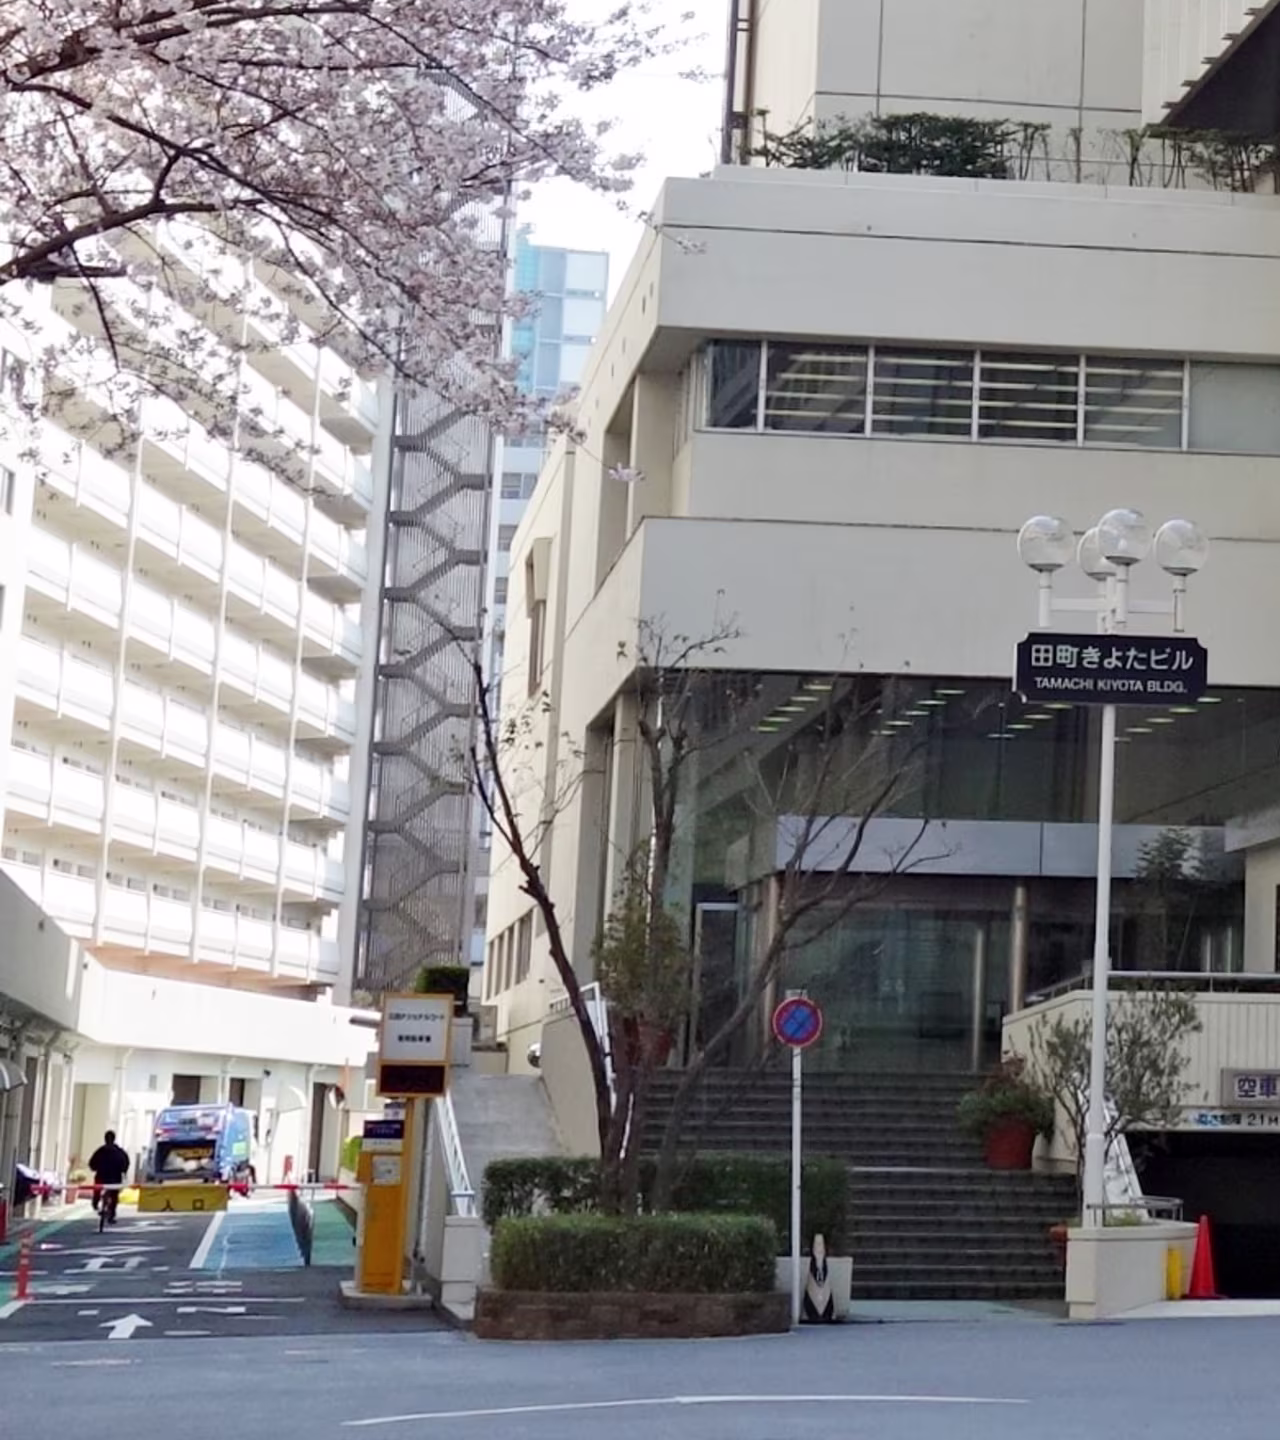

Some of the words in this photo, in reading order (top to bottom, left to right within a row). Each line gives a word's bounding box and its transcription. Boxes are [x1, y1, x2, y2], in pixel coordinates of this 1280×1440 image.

[1031, 644, 1193, 670] 田町きよたビル
[1035, 677, 1093, 690] TAMACHI
[1097, 678, 1143, 692] KIYOTA
[1147, 680, 1187, 693] BLDG.
[1236, 1076, 1278, 1099] 空車
